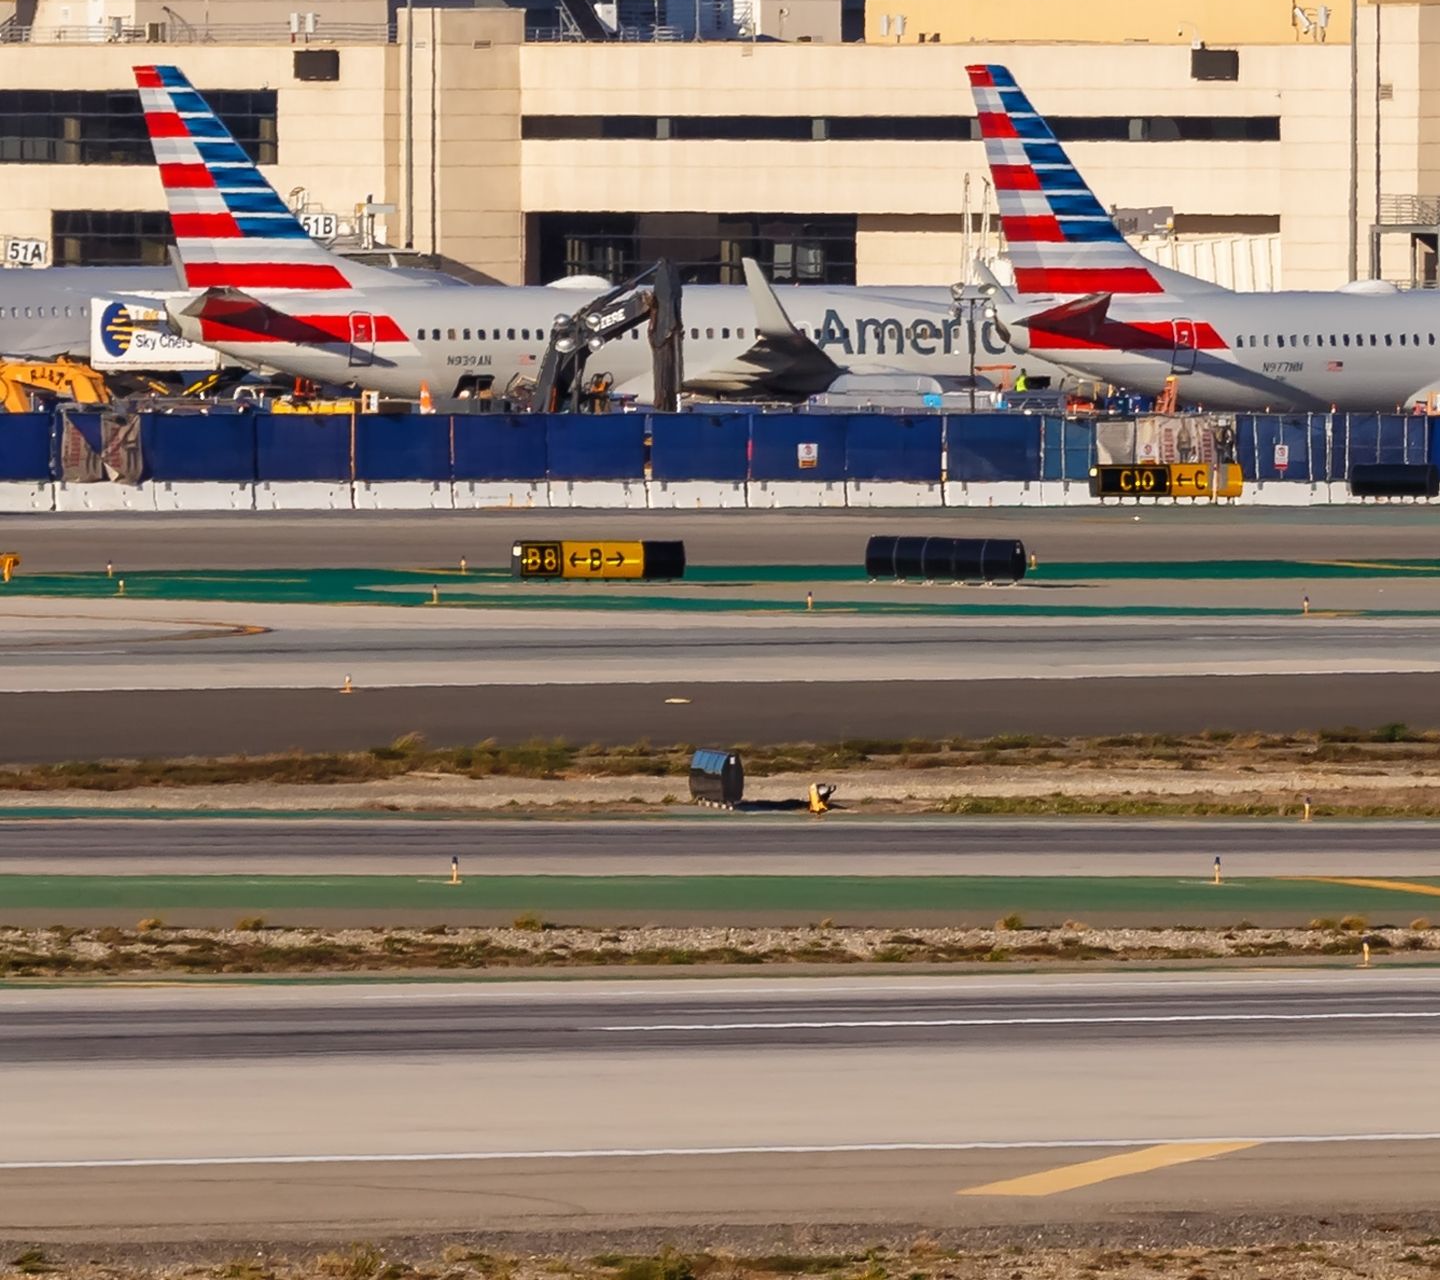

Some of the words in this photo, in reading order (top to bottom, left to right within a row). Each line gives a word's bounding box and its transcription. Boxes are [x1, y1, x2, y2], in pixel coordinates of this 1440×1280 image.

[303, 216, 333, 235] 51B
[9, 242, 43, 262] 51A
[136, 334, 156, 351] Sky
[1194, 471, 1207, 491] C
[527, 547, 556, 571] B8
[590, 548, 603, 572] B
